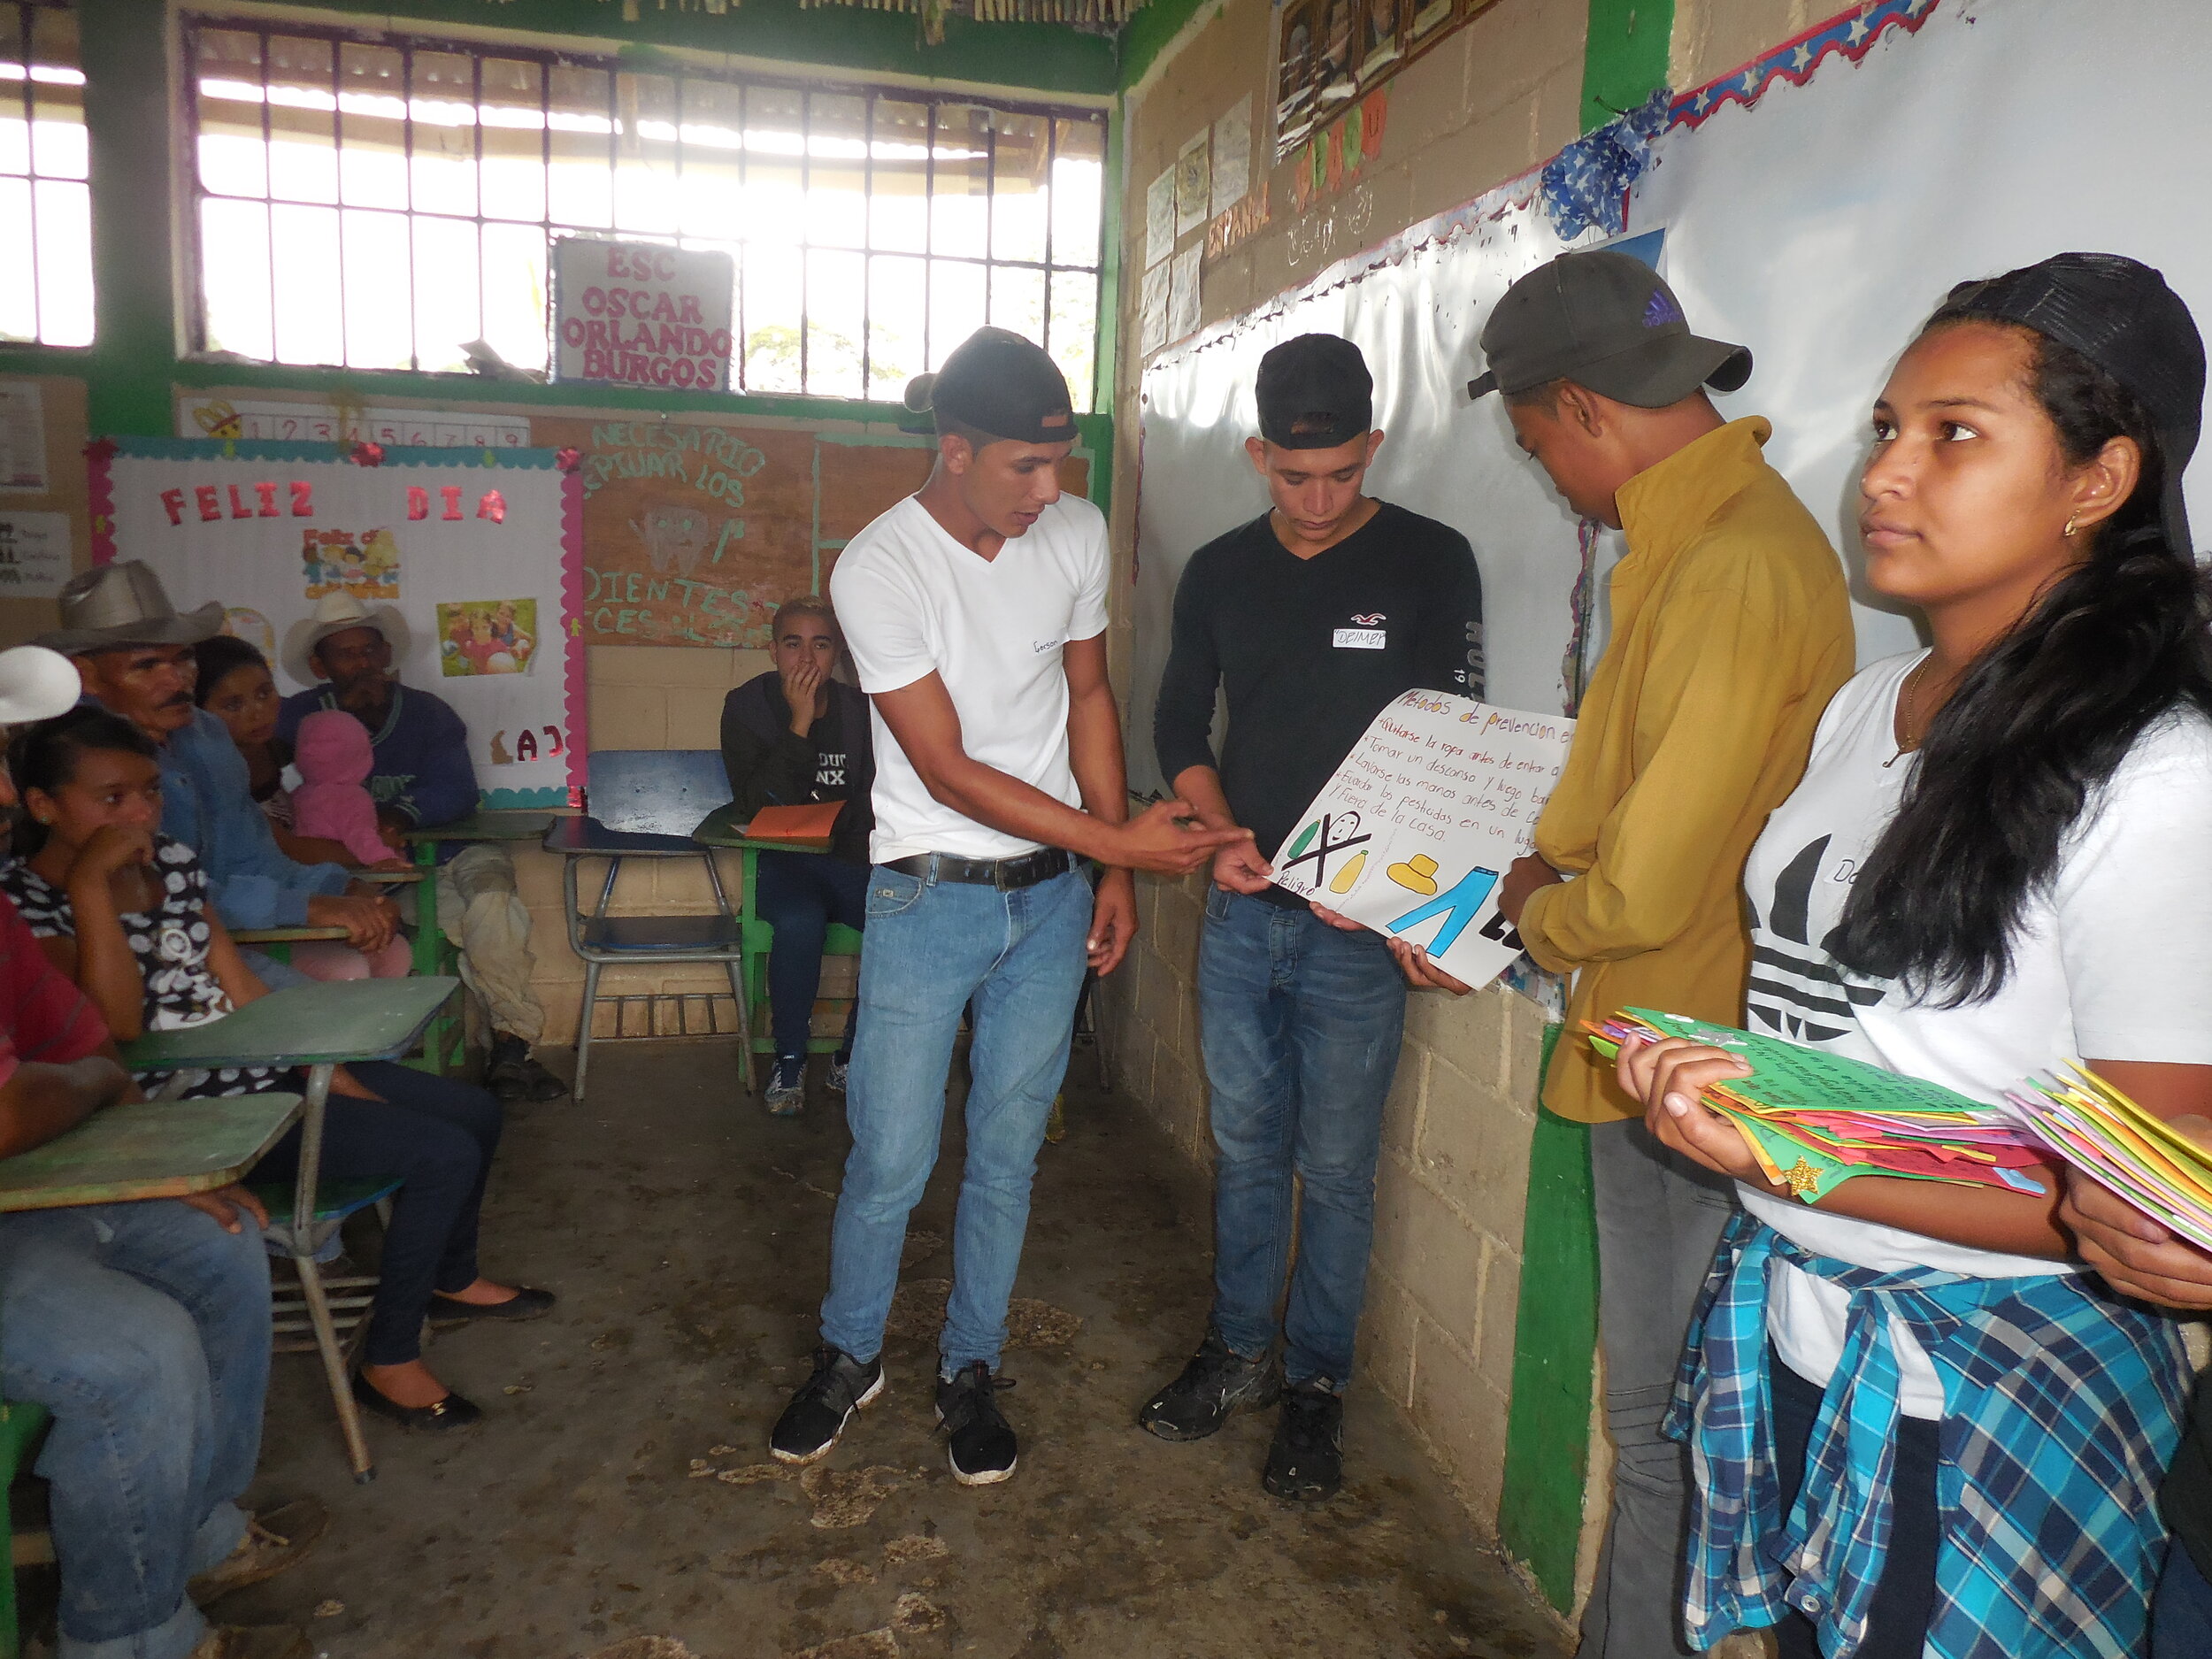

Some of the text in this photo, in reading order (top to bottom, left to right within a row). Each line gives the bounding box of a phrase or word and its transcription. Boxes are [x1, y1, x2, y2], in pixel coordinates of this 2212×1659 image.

[607, 246, 675, 281] ESC
[582, 286, 703, 324] OSCAR
[562, 317, 732, 358] ORLANDO
[583, 349, 717, 389] BURGOS
[282, 420, 297, 441] 2
[314, 424, 331, 442] 3
[381, 429, 396, 445] 5
[505, 434, 518, 447] 9
[592, 422, 765, 477] NECESARIO
[160, 481, 507, 526] FELIZ DIA
[695, 465, 744, 507] LOS
[1398, 691, 1452, 714] Metodos
[1459, 703, 1479, 724] de
[1480, 712, 1555, 740] prevencion
[1370, 736, 1403, 759] Tomar
[1407, 755, 1423, 764] un
[1426, 758, 1476, 783] descanso
[1497, 779, 1522, 803] luego
[1425, 734, 1437, 749] la
[1441, 743, 1464, 757] ropa
[1469, 751, 1494, 764] antes
[1499, 752, 1513, 769] de
[1517, 760, 1545, 773] entrar
[1551, 766, 1559, 777] a
[1355, 752, 1393, 782] Lavarse
[1396, 773, 1411, 787] las
[1417, 780, 1455, 799] manos
[1463, 794, 1496, 811] antes
[1501, 802, 1518, 818] de
[1371, 802, 1386, 818] de
[1391, 810, 1405, 824] la
[1380, 784, 1393, 801] los
[1396, 796, 1452, 824] pesticidas
[1460, 818, 1479, 830] en
[1489, 826, 1504, 838] un
[1277, 871, 1315, 895] Peligro
